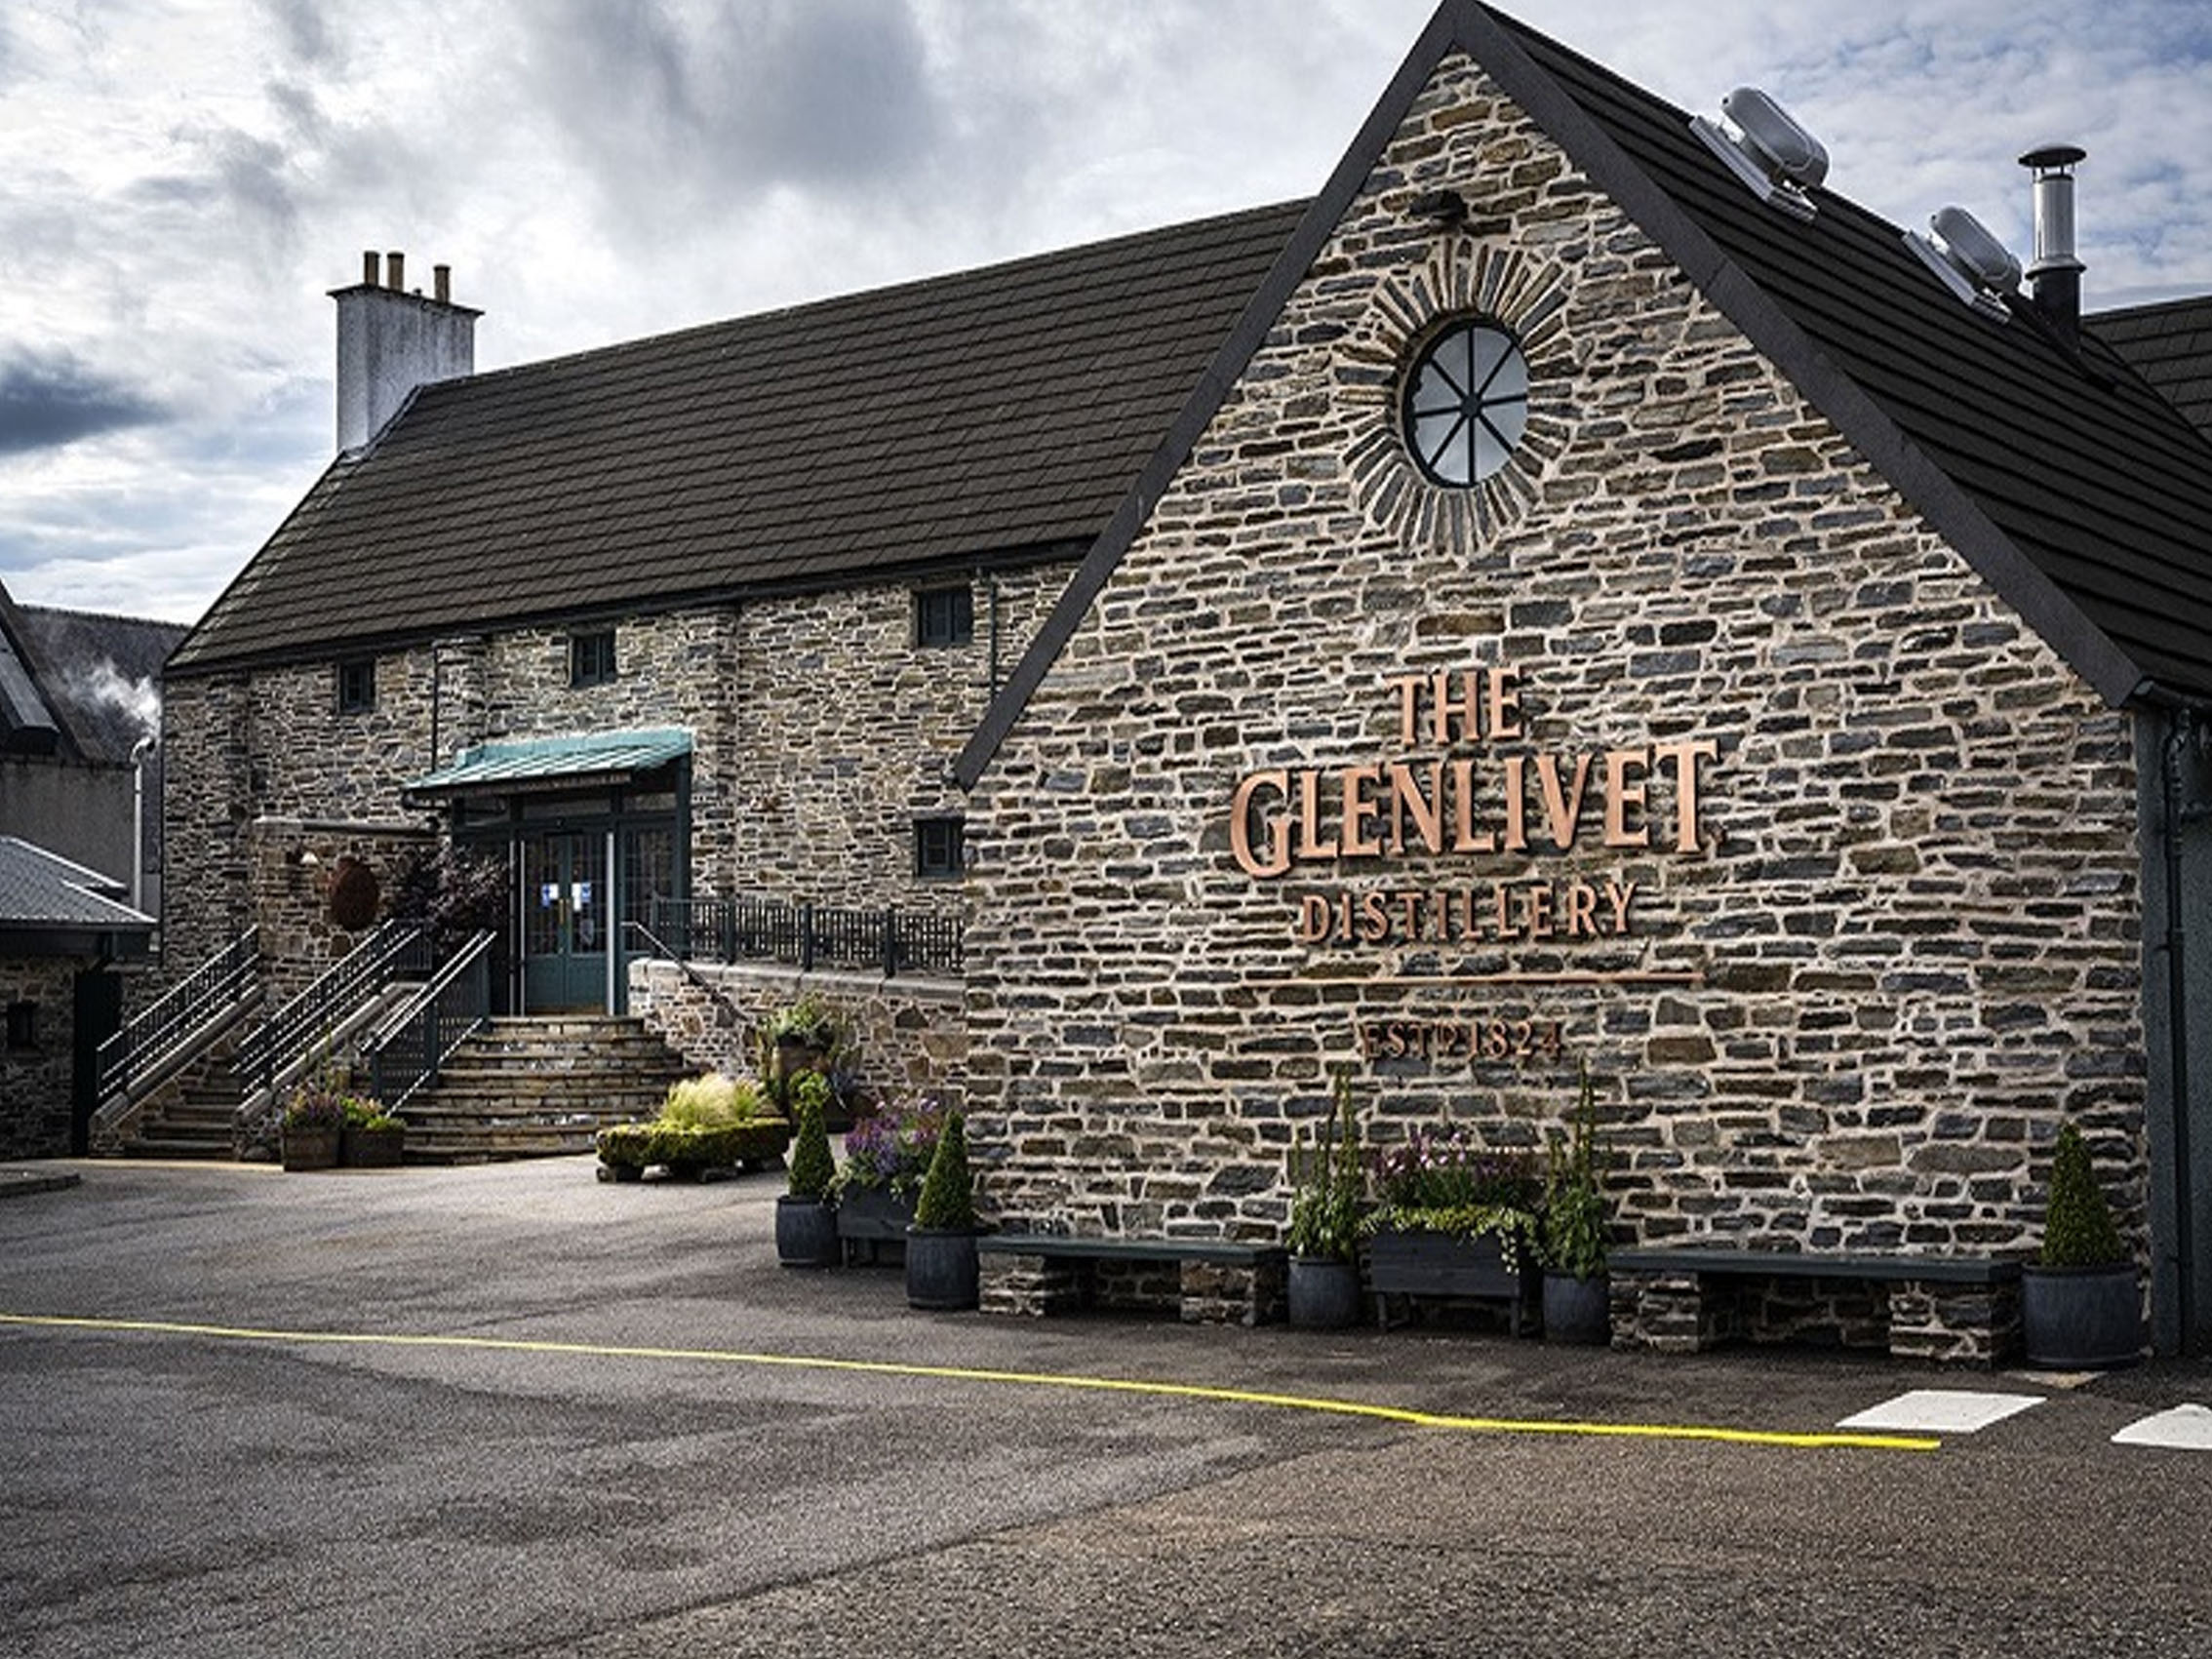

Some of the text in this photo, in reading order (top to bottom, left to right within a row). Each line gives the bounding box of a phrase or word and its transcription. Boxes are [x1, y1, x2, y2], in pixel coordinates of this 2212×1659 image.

[1390, 667, 1521, 744] THE
[1230, 740, 1718, 877] GLENLIVET
[1301, 882, 1637, 942] DISTILLERY
[1467, 1020, 1561, 1056] 1824
